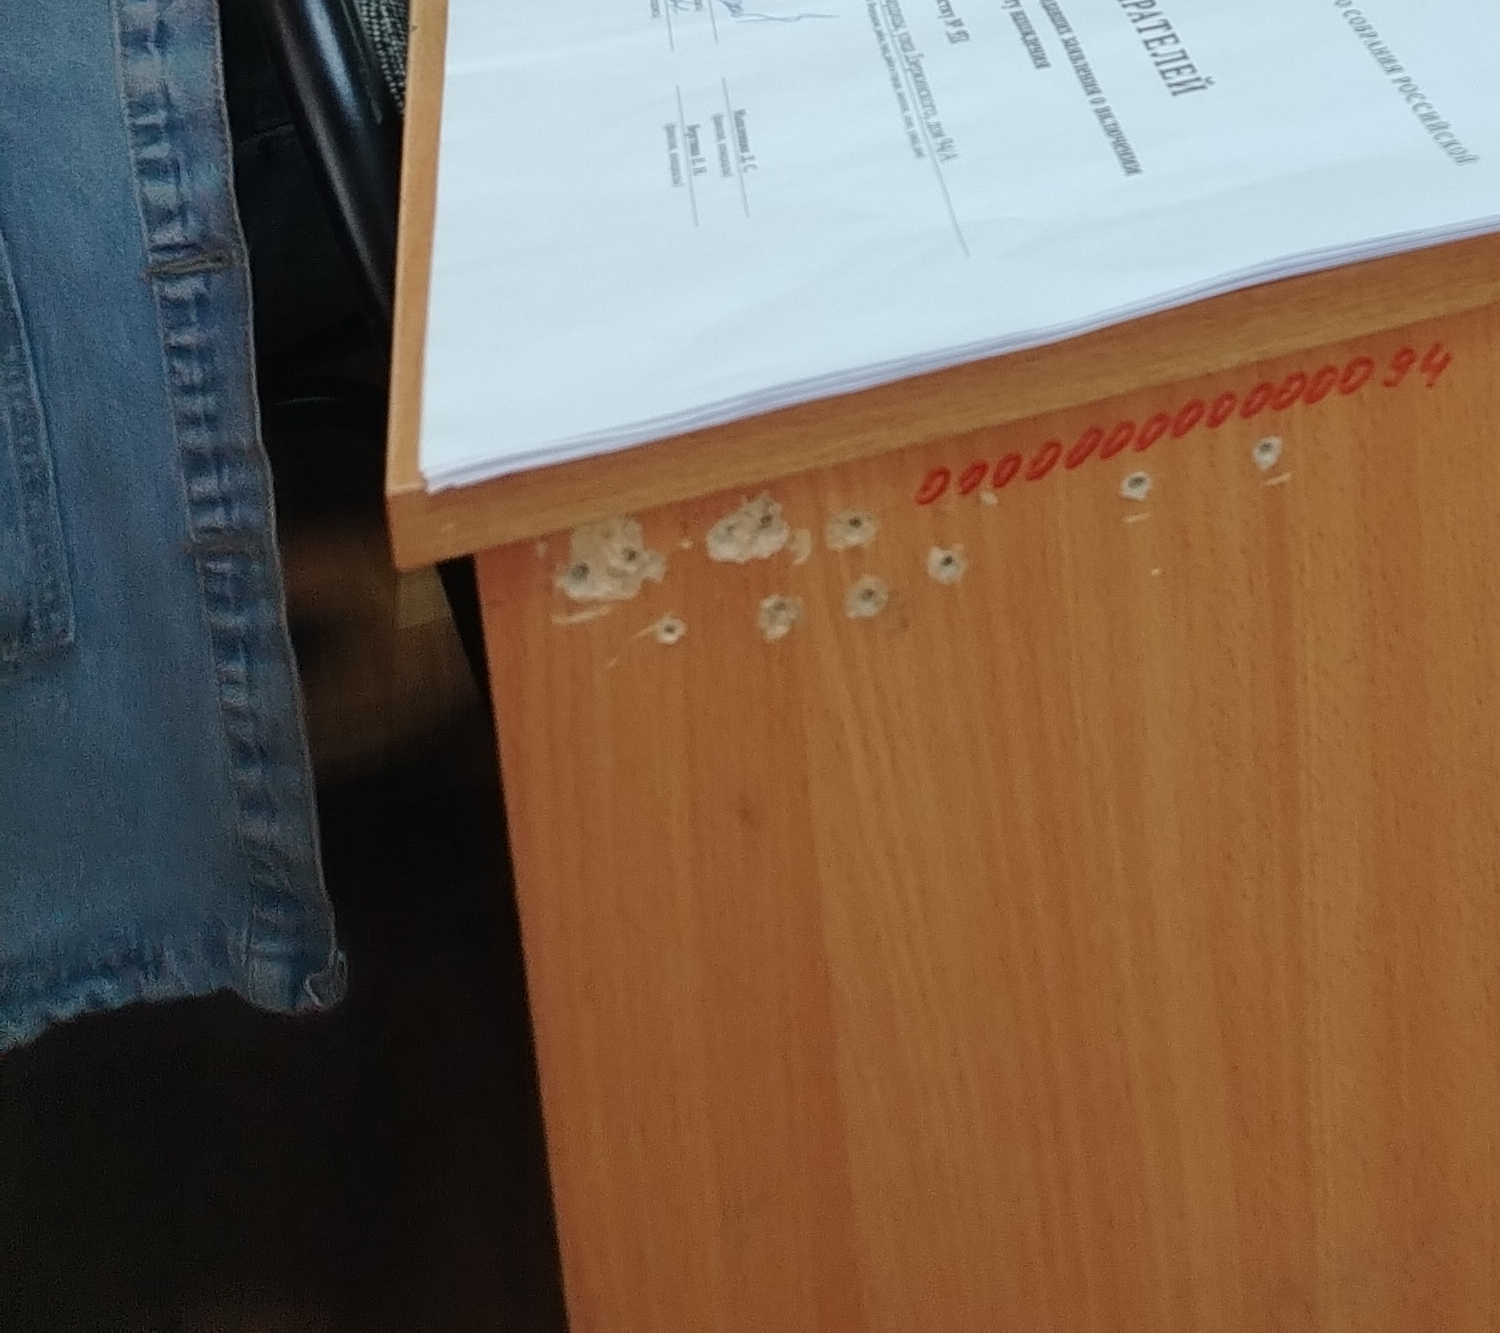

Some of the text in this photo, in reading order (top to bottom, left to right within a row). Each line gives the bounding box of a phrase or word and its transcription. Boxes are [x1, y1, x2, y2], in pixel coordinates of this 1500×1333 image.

[899, 53, 938, 120] Дзержинского,
[1061, 36, 1102, 97] заявления
[1093, 106, 1142, 176] включении
[1342, 9, 1404, 75] СОБРАНИЯ
[1391, 76, 1479, 166] РОССИЙСКОЙ
